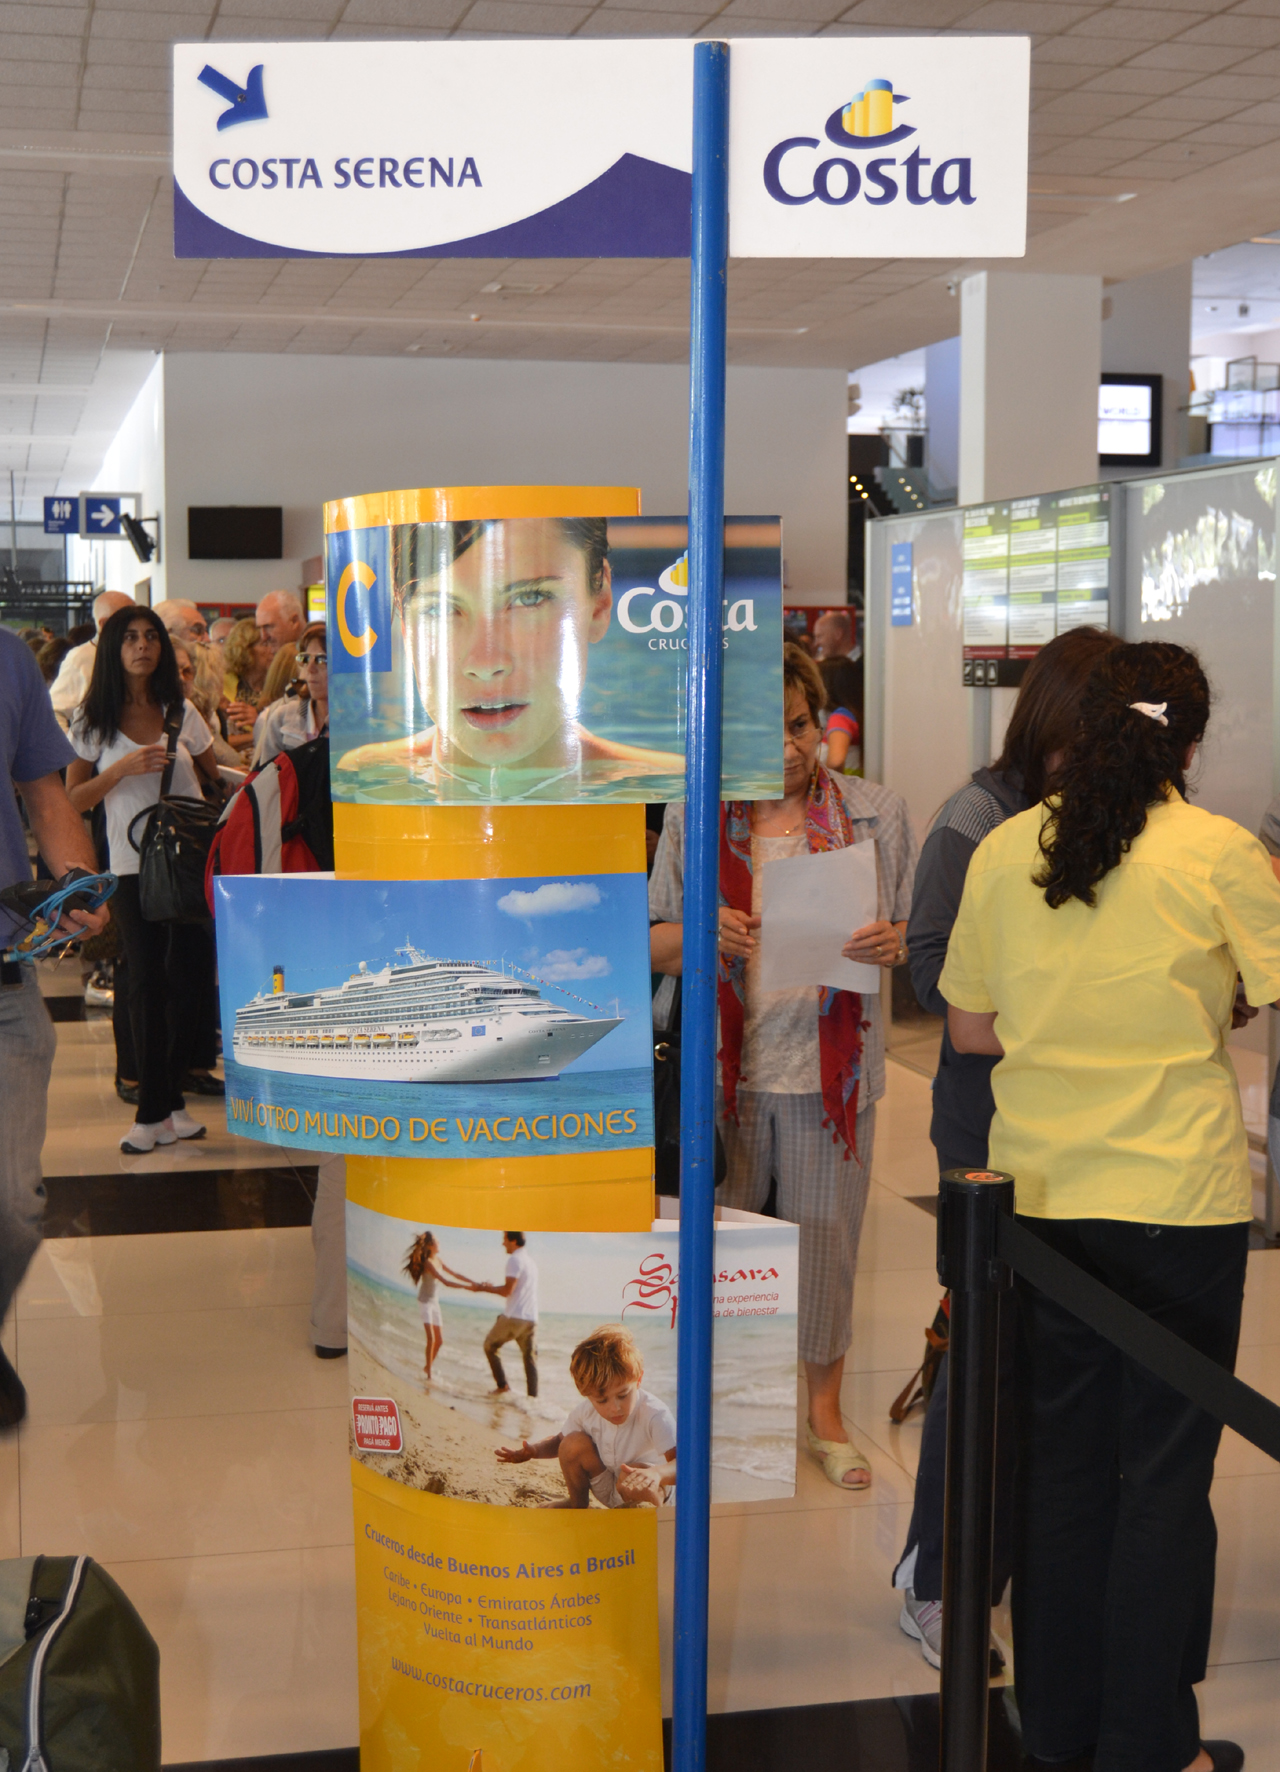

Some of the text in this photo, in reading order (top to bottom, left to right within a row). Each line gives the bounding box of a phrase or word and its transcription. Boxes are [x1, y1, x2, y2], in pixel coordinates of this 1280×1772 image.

[208, 157, 483, 191] COSTA SERENA
[763, 137, 977, 206] Costa
[336, 559, 379, 658] C
[617, 587, 759, 634] Coa
[648, 637, 730, 651] CRUCS
[231, 1096, 638, 1143] VIVÍ OTRO MUNDO DE VACACIONES
[722, 1308, 735, 1318] de
[737, 1306, 780, 1317] bienestar
[727, 1292, 780, 1305] experiencia
[365, 1523, 636, 1579] Cruceros desde Buenos Aires a Brasil
[383, 1566, 601, 1611] Caribe Europa Emiratos Árabes
[388, 1587, 593, 1631] Lejano Oriente Transatlánticos
[423, 1622, 534, 1652] Vuelta al Mundo
[391, 1656, 592, 1702] www.costacruceros.com
